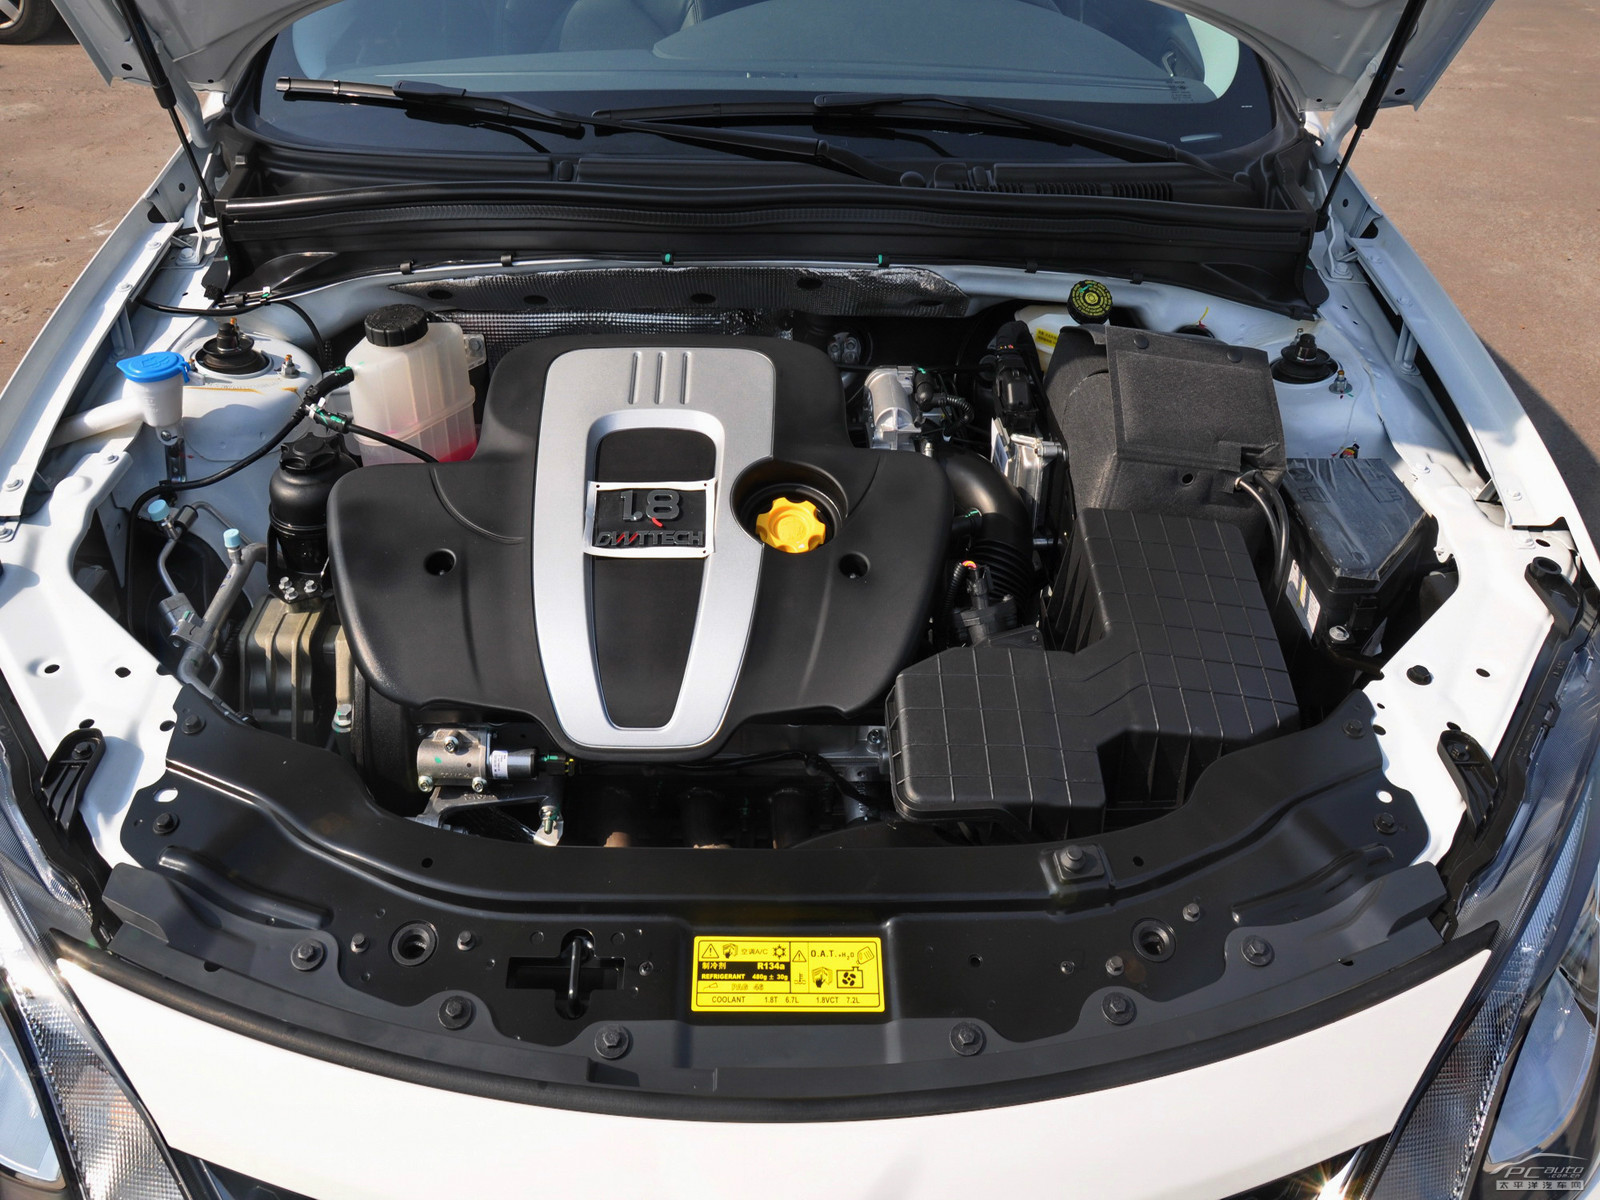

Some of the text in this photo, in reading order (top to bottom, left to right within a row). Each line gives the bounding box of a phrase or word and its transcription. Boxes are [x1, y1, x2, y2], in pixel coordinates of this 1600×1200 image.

[620, 489, 680, 520] 1.8
[701, 961, 786, 970] 制冷剂 R134a
